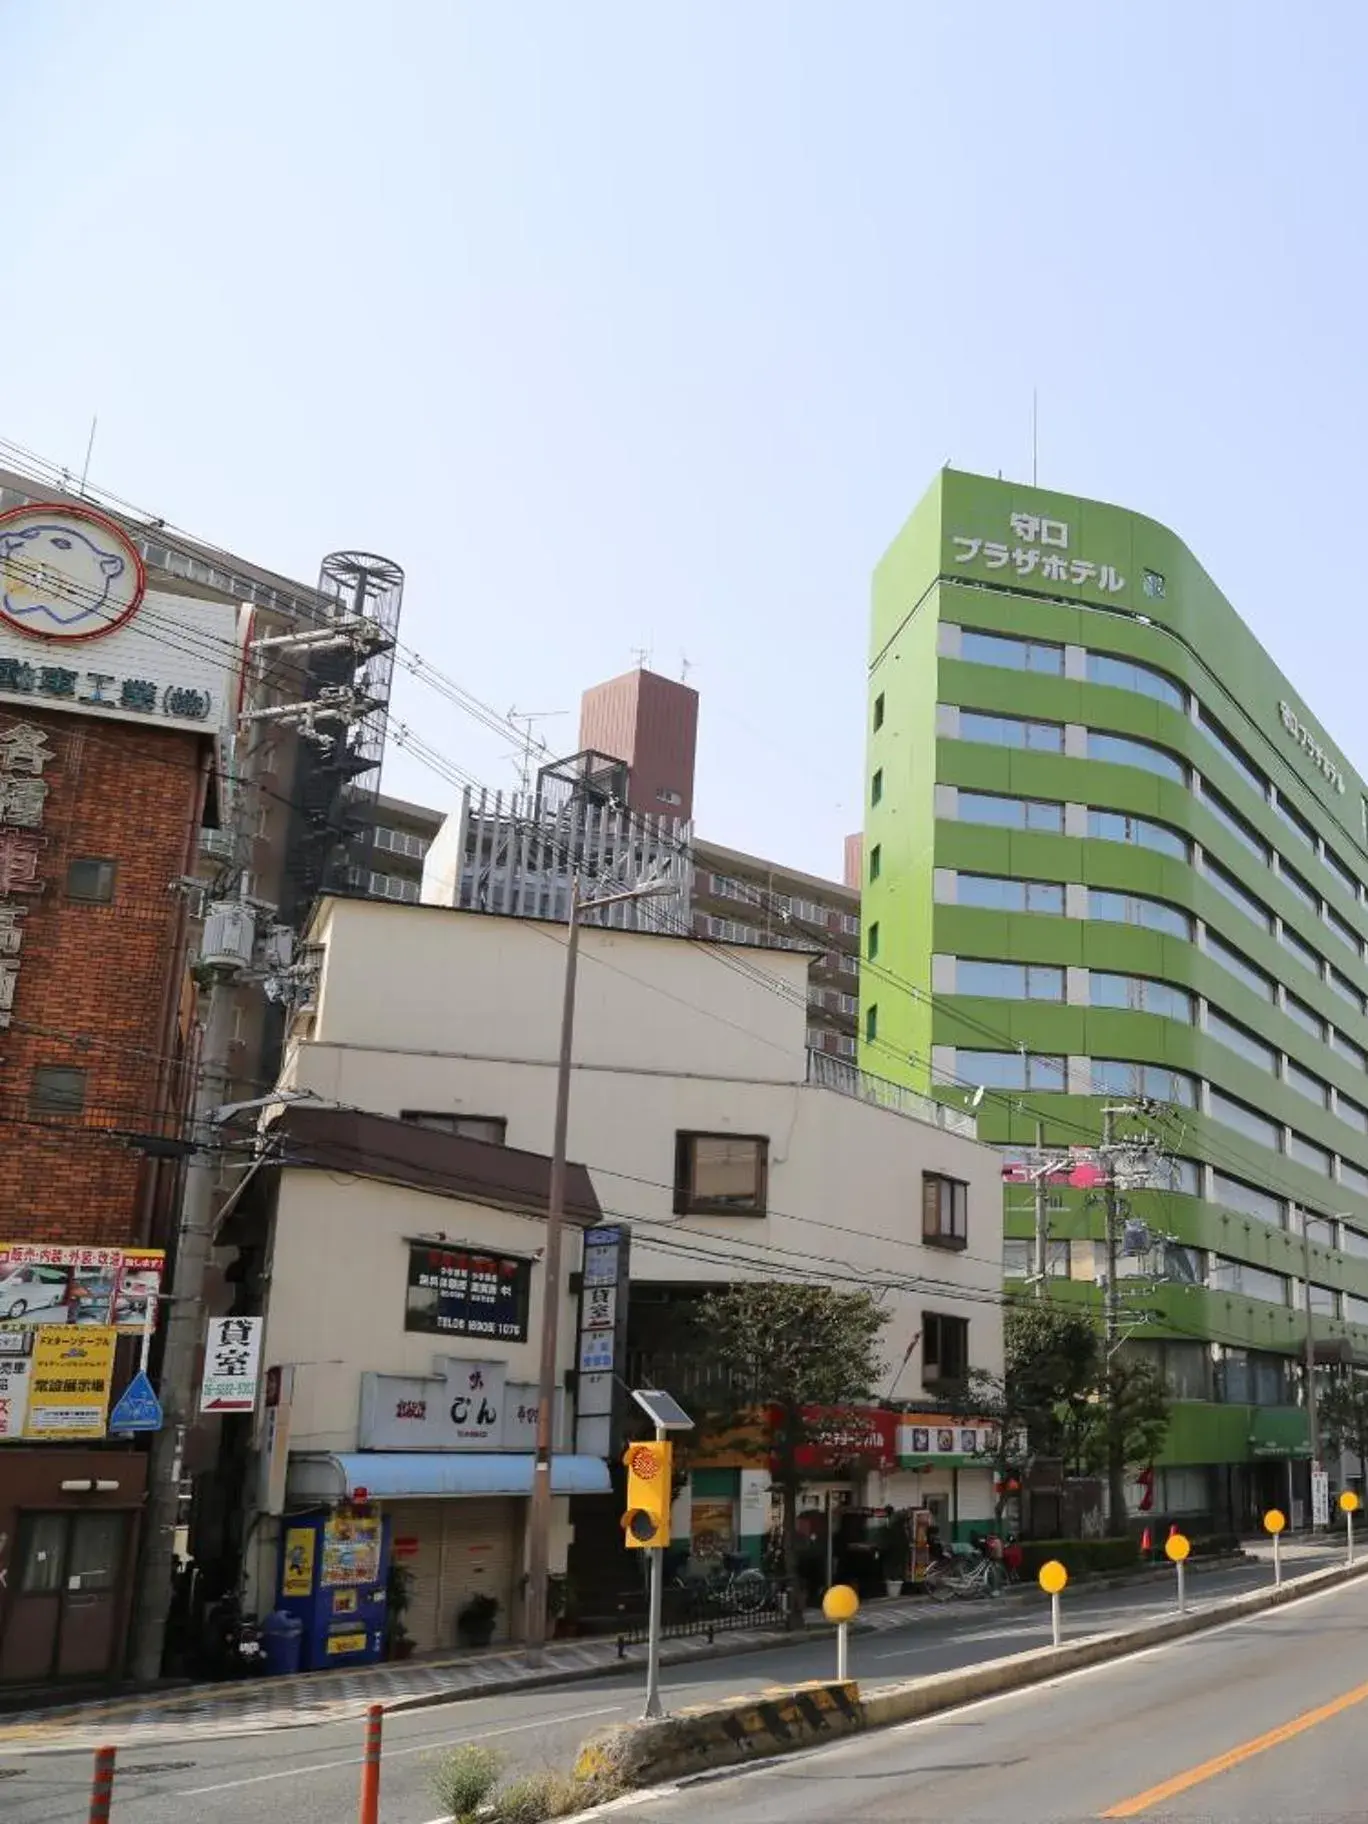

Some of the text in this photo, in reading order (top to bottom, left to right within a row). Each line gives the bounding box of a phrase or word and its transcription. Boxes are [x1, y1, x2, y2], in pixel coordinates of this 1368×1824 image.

[1010, 511, 1069, 549] 守口
[953, 536, 1126, 592] プラザホテル
[212, 1318, 254, 1377] 貸室
